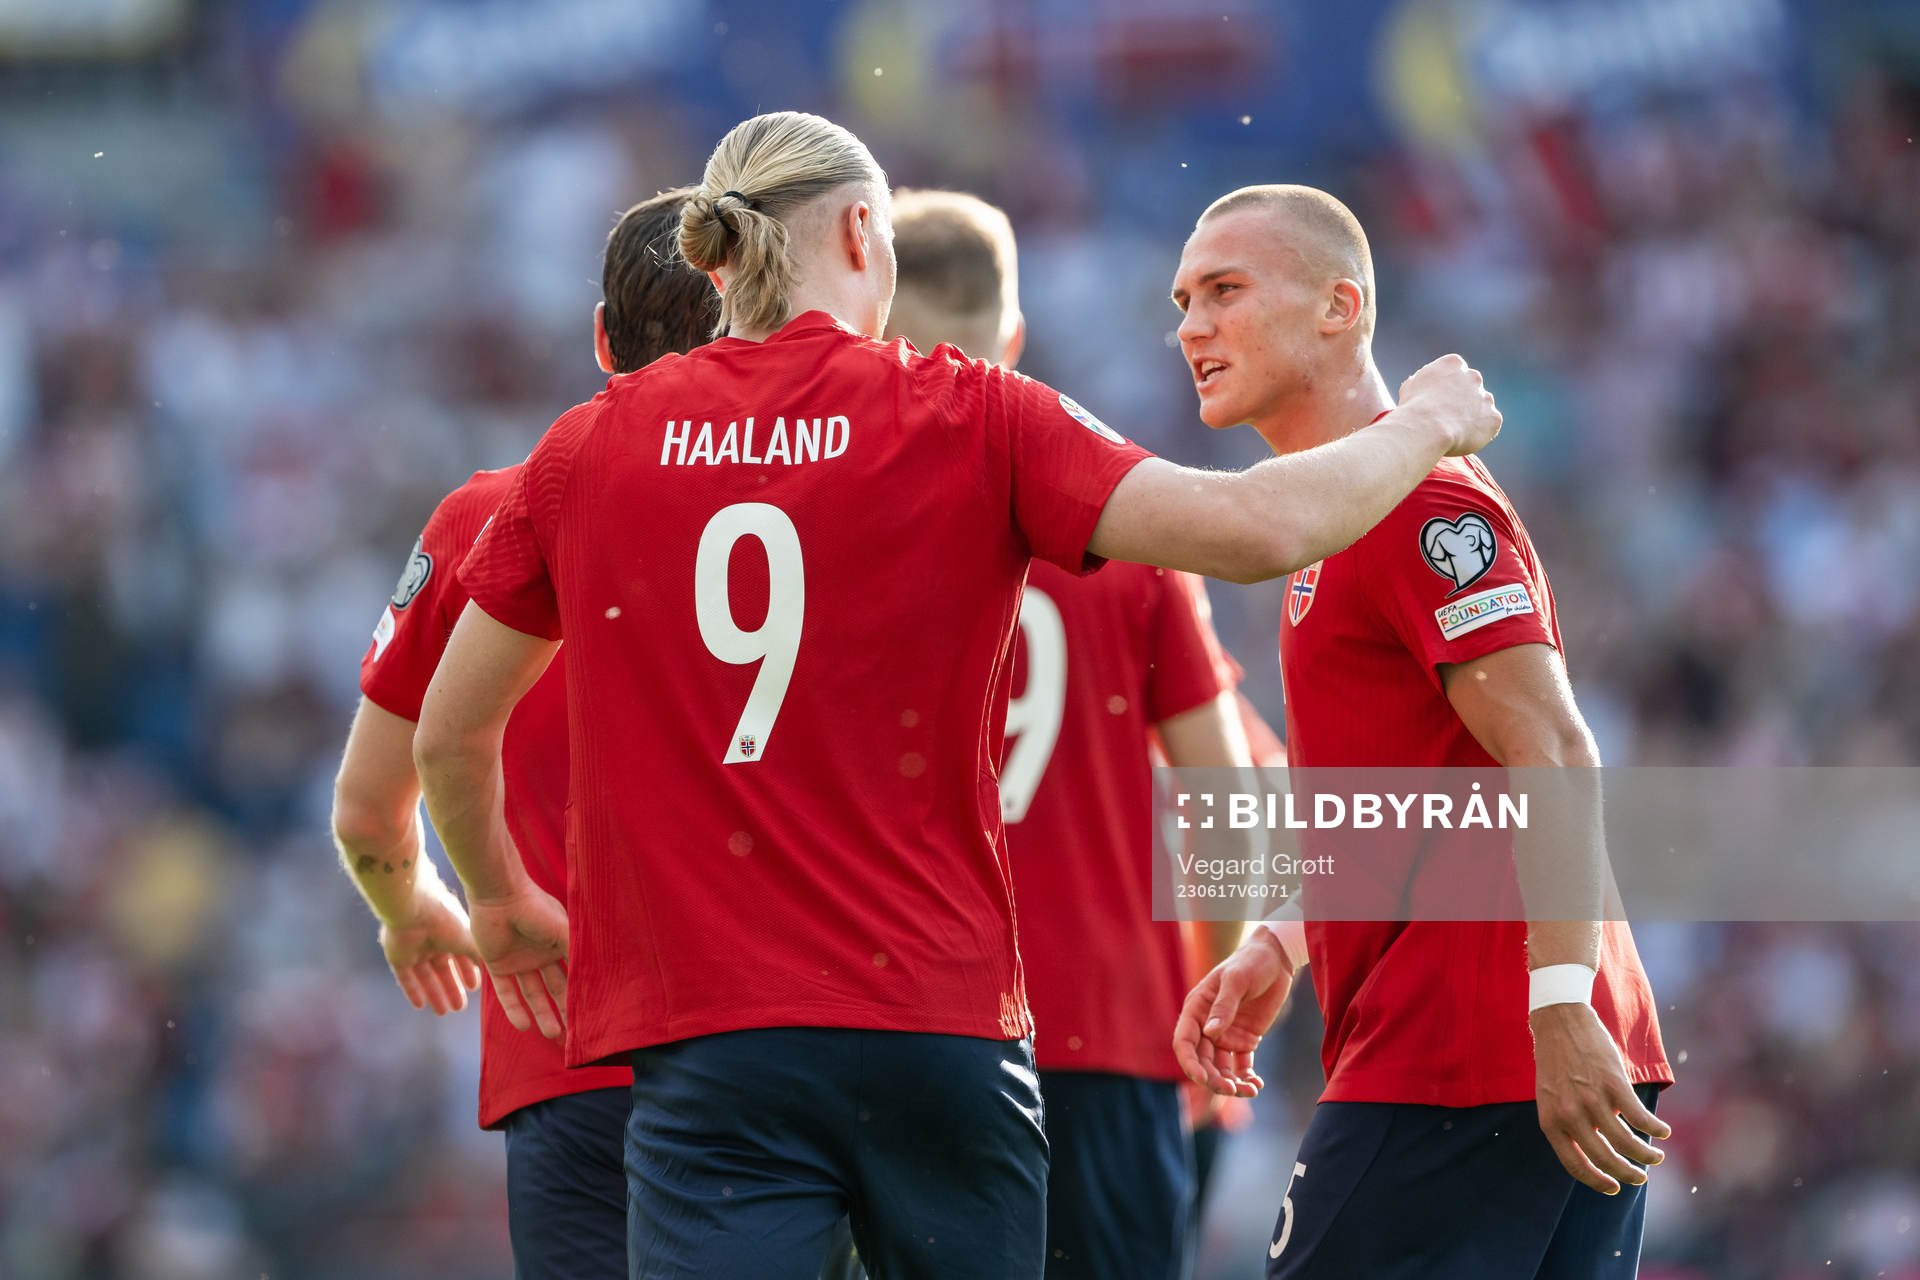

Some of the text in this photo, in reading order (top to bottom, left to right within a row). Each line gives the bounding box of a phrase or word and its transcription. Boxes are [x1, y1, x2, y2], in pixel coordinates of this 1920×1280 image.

[660, 415, 850, 465] HAALAND
[695, 502, 805, 764] 9
[1437, 604, 1458, 618] UEFA
[1440, 592, 1529, 630] FOUNDATION
